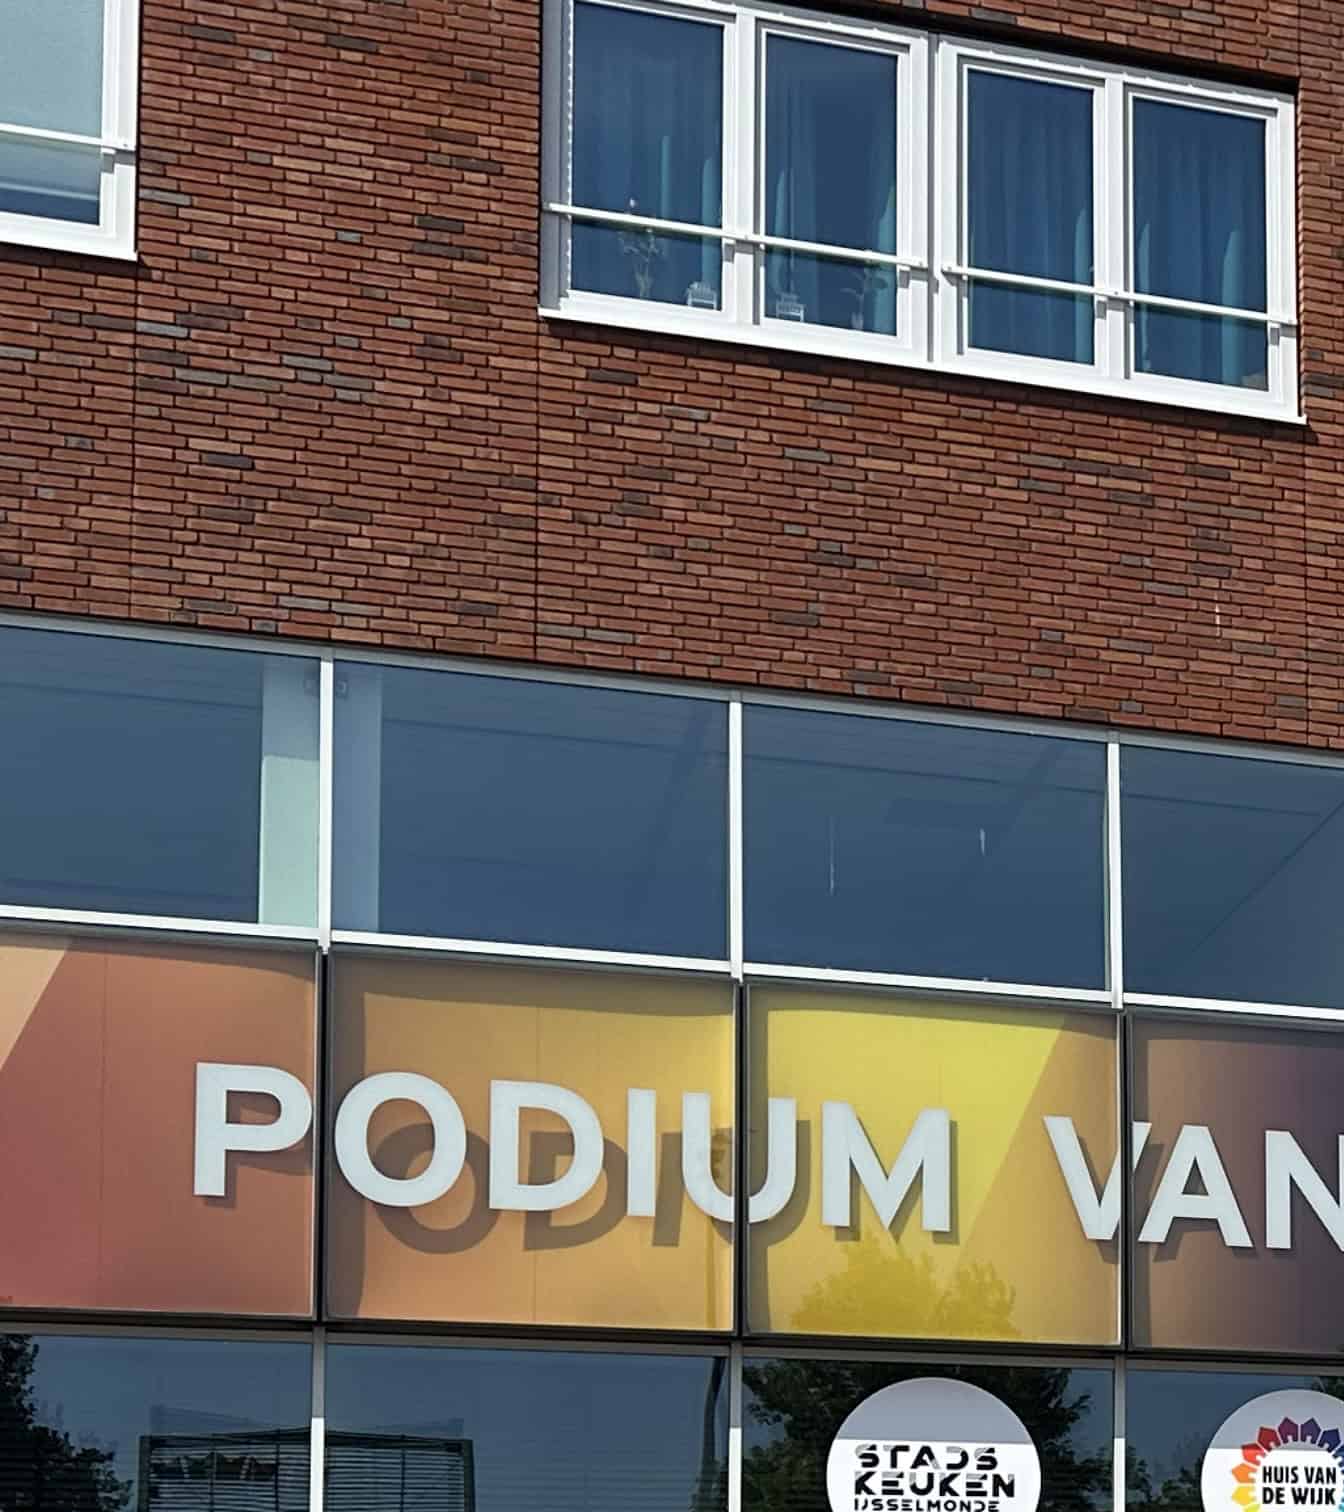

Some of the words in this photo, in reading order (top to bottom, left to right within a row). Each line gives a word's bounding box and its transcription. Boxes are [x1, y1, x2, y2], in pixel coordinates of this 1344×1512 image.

[193, 1062, 953, 1232] PODIUM
[855, 1444, 998, 1470] STADS
[855, 1471, 1015, 1498] KEUKEN
[1262, 1466, 1299, 1484] HUIS
[1304, 1466, 1337, 1485] VAN
[854, 1498, 1000, 1512] IJSSELMONDE
[1262, 1487, 1286, 1505] DE
[1291, 1488, 1336, 1505] WIJK
